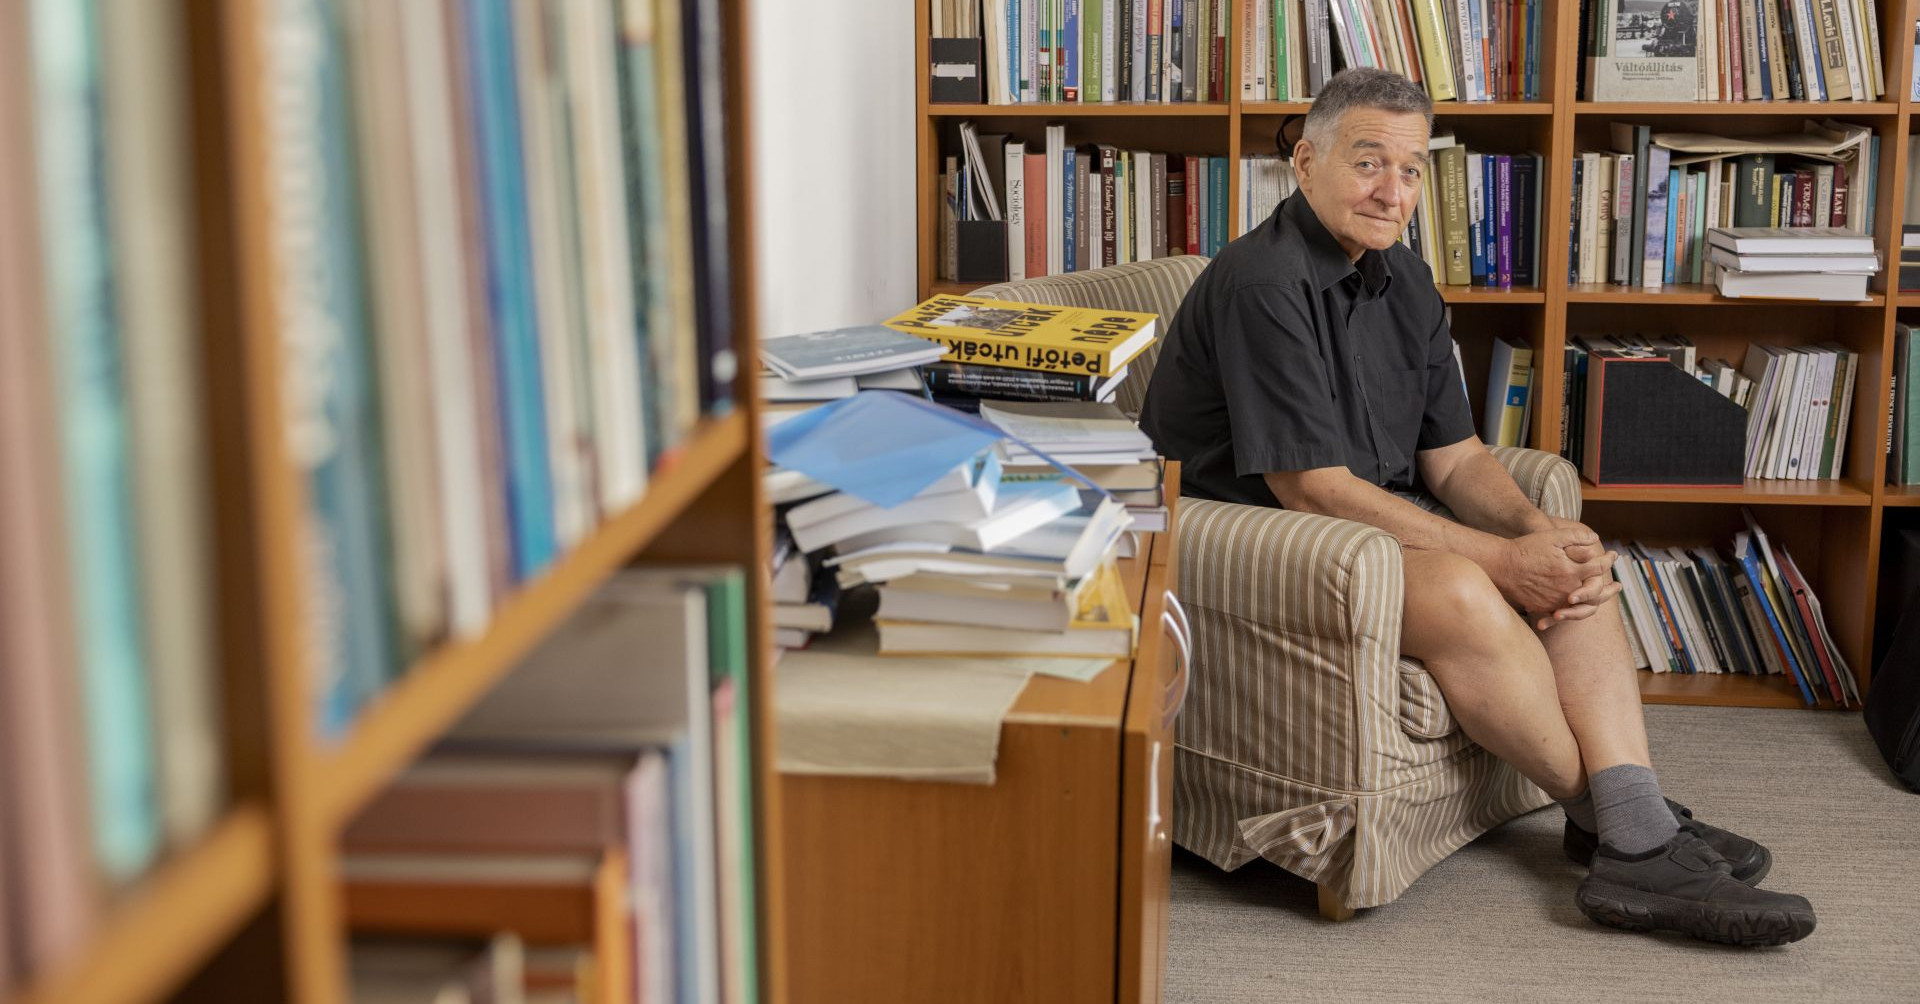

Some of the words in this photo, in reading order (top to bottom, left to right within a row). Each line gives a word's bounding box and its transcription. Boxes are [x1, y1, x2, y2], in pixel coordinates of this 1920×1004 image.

[1823, 8, 1836, 37] Lewis
[1087, 84, 1099, 95] 12
[1105, 174, 1113, 185] The
[1622, 162, 1632, 181] STAY
[1066, 182, 1074, 213] American
[1104, 186, 1113, 211] Enduring
[1457, 172, 1465, 199] HISTORY
[1802, 181, 1812, 210] FORMS
[1010, 179, 1022, 225] Sociology
[1833, 185, 1848, 215] TEAM
[1105, 211, 1113, 229] Vision
[895, 298, 984, 330] Petőfi
[1071, 317, 1136, 344] népe
[949, 340, 1020, 361] utcák
[1026, 347, 1102, 373] Petőfi
[1886, 415, 1894, 454] REVOLUTION
